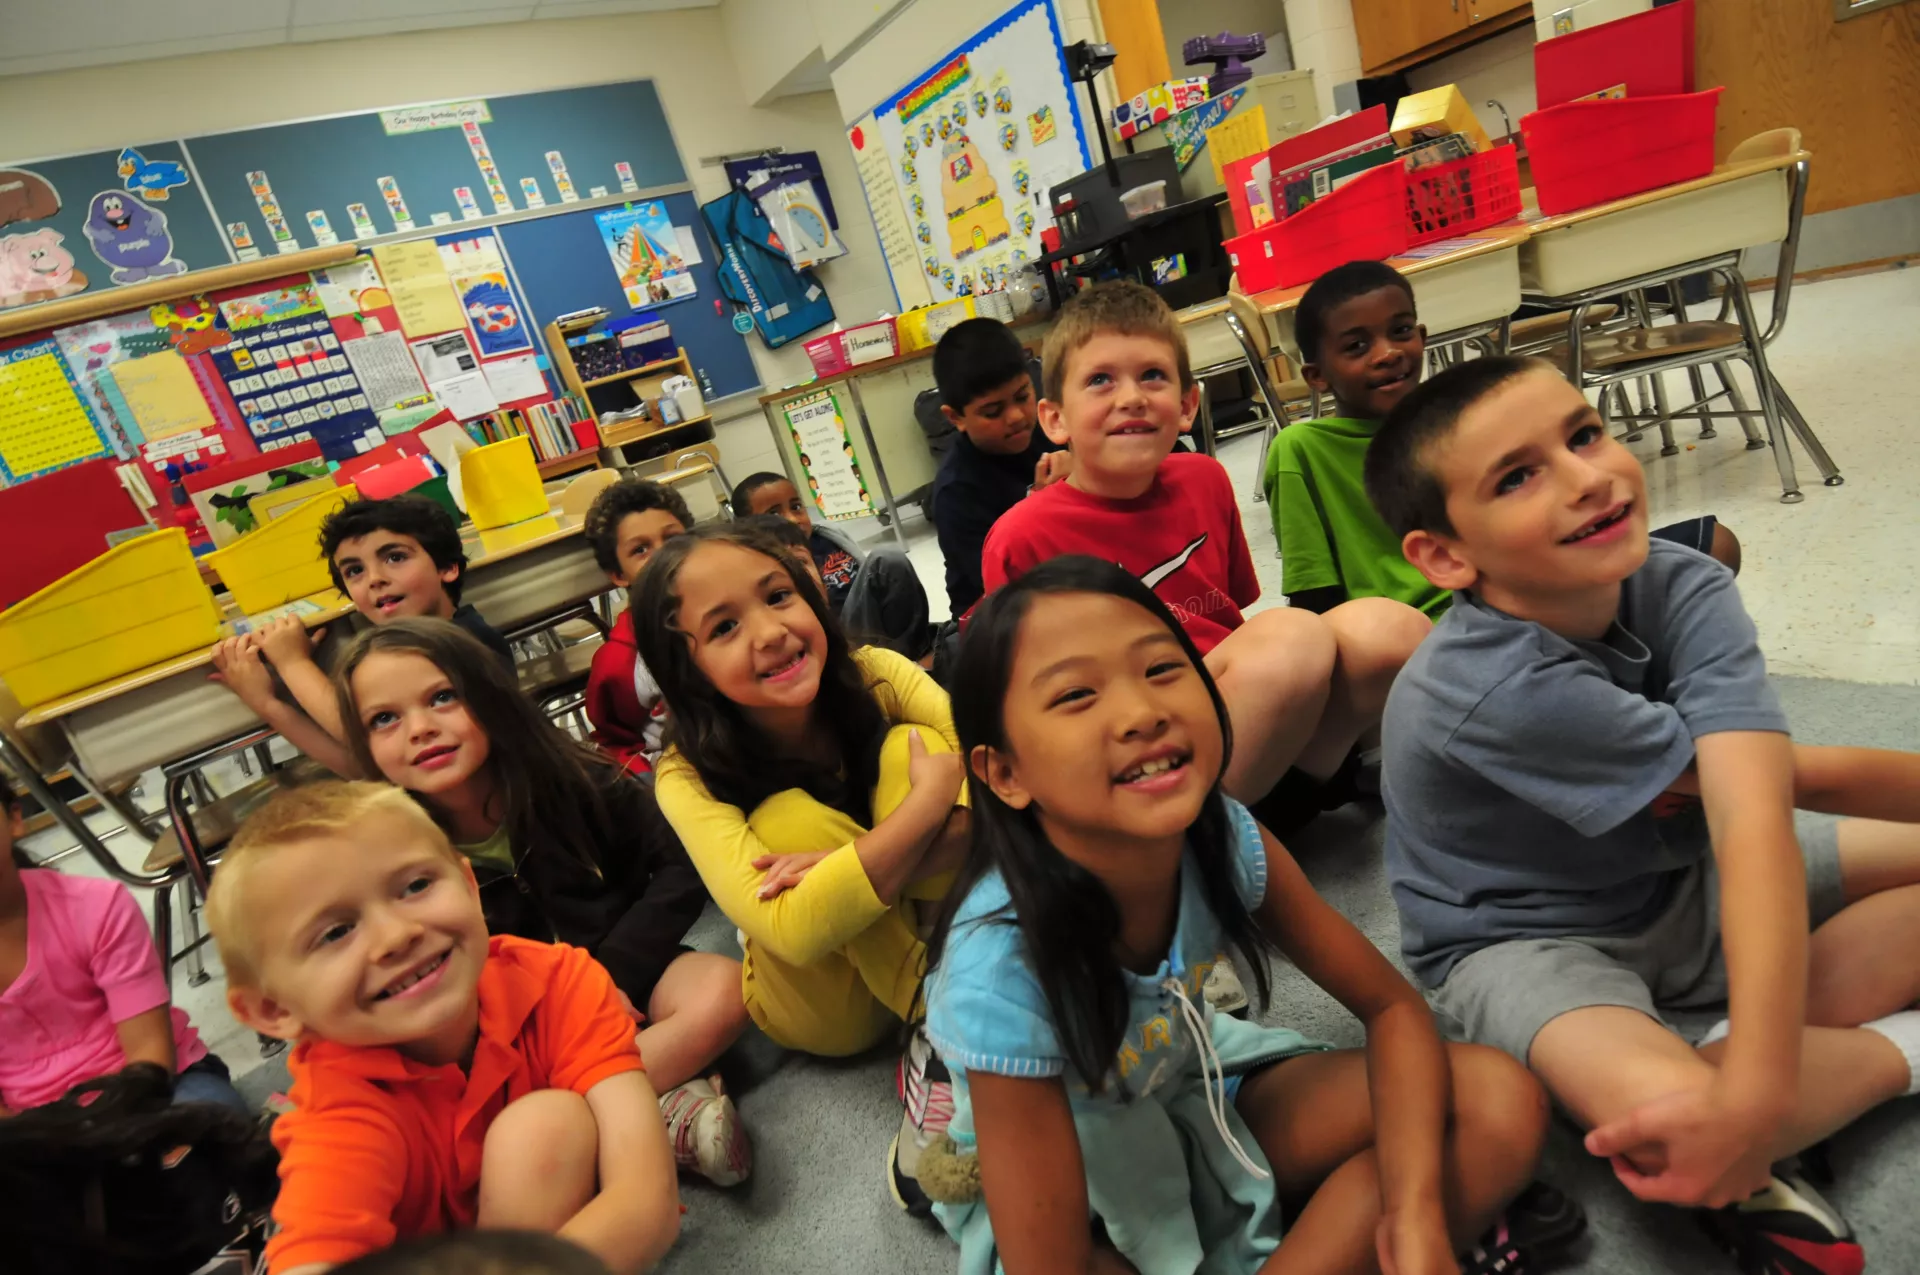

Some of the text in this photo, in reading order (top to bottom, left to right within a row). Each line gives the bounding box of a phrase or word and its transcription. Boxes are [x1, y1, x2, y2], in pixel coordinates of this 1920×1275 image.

[118, 238, 151, 254] purple
[849, 332, 890, 352] Homework
[12, 342, 51, 362] Chart
[815, 402, 834, 417] ALONG
